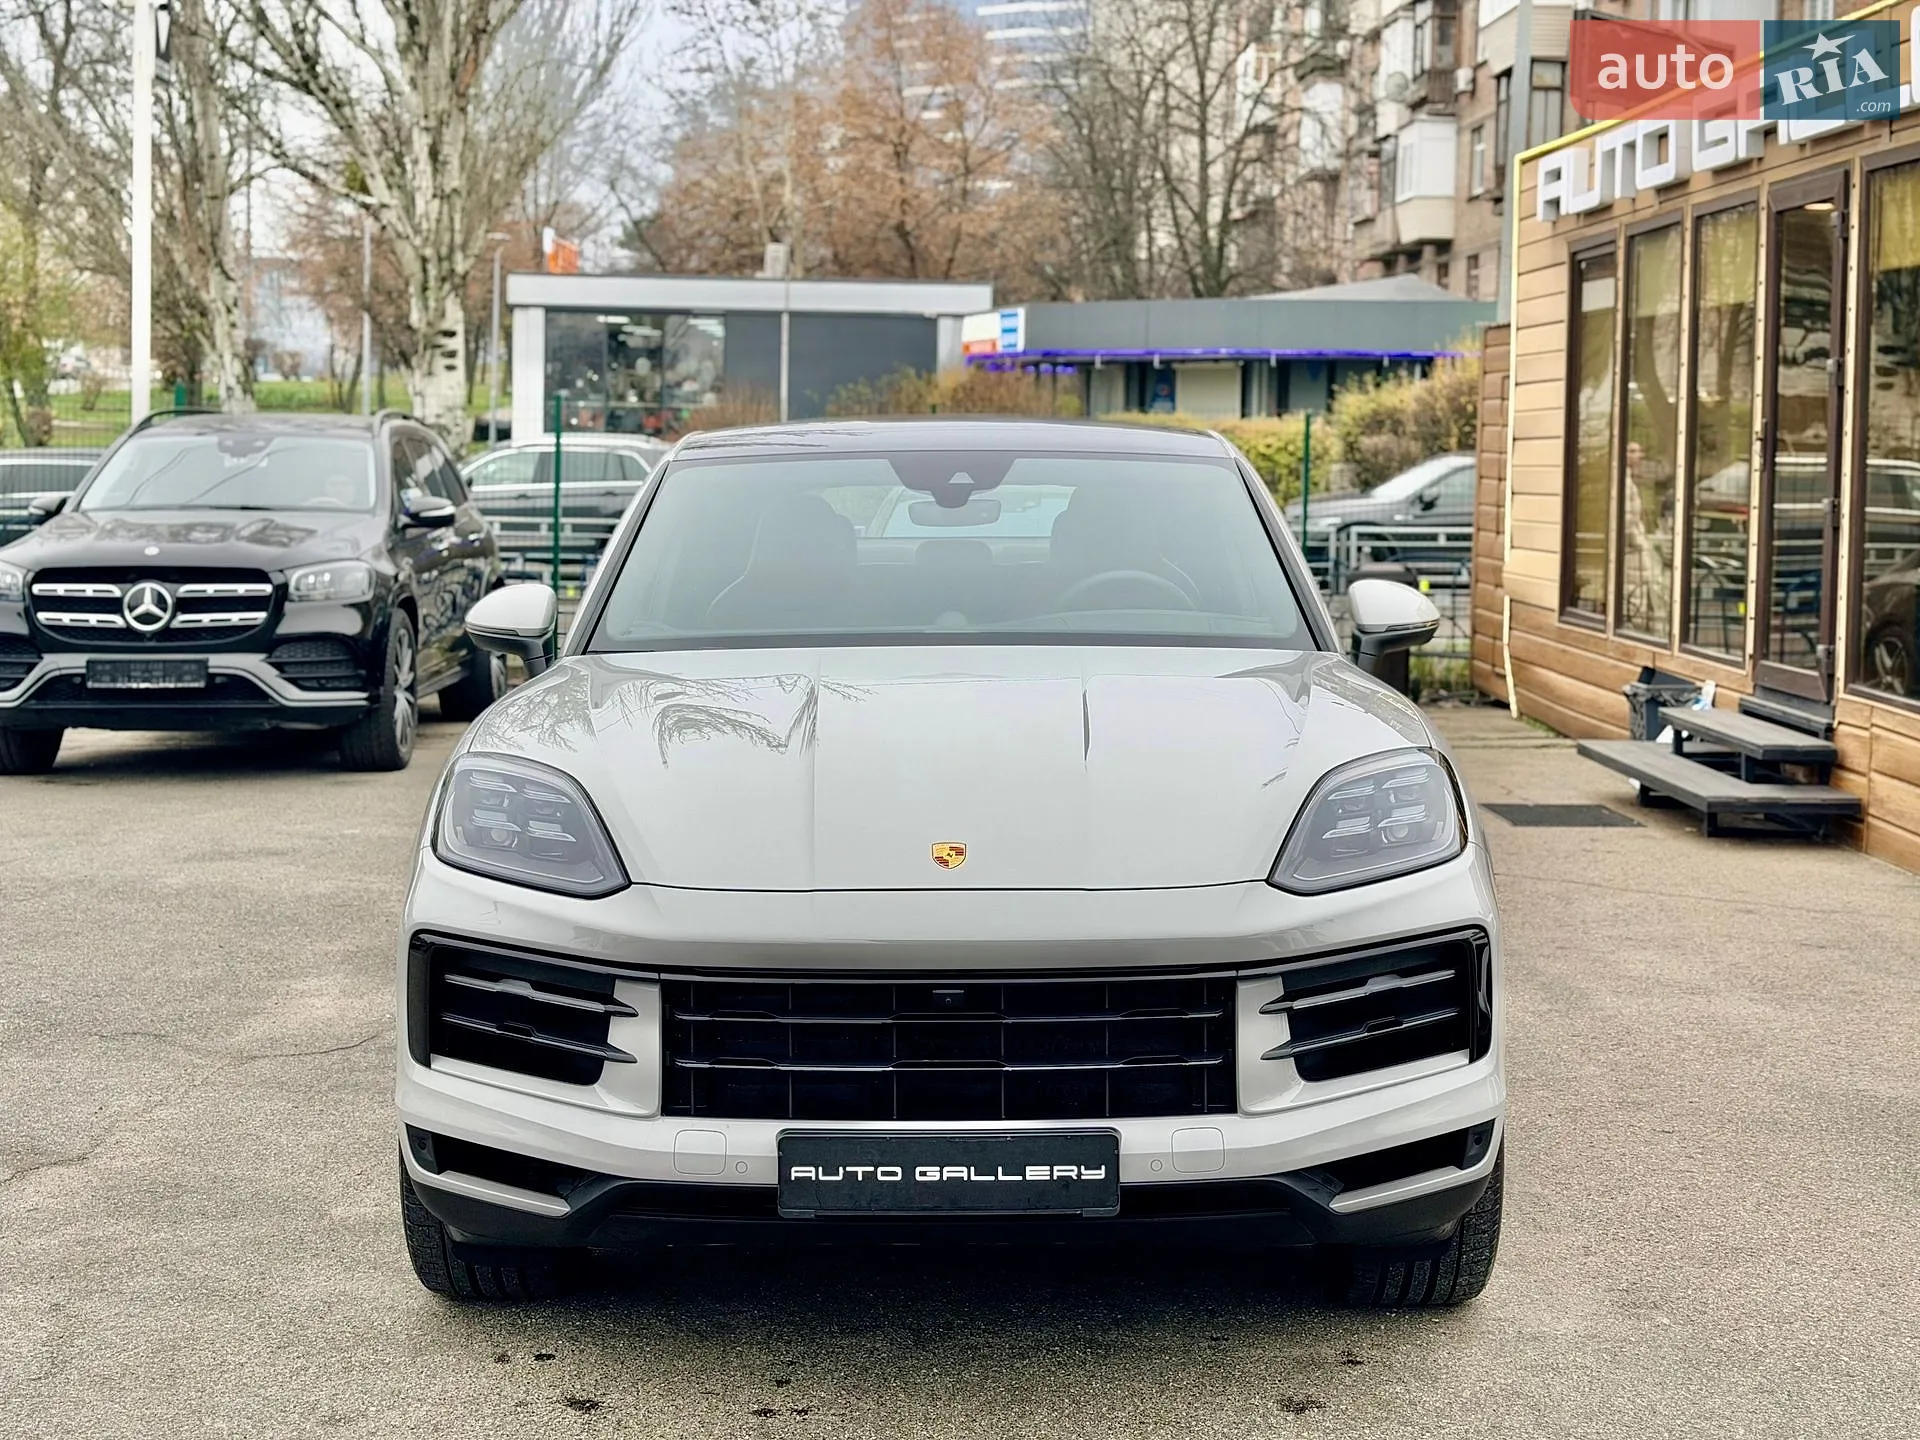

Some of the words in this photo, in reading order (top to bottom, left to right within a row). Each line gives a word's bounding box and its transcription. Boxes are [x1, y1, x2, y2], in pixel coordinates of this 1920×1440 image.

[1536, 110, 1680, 222] AUTO
[790, 1166, 902, 1181] AUTO
[915, 1164, 1106, 1181] GALLERY
